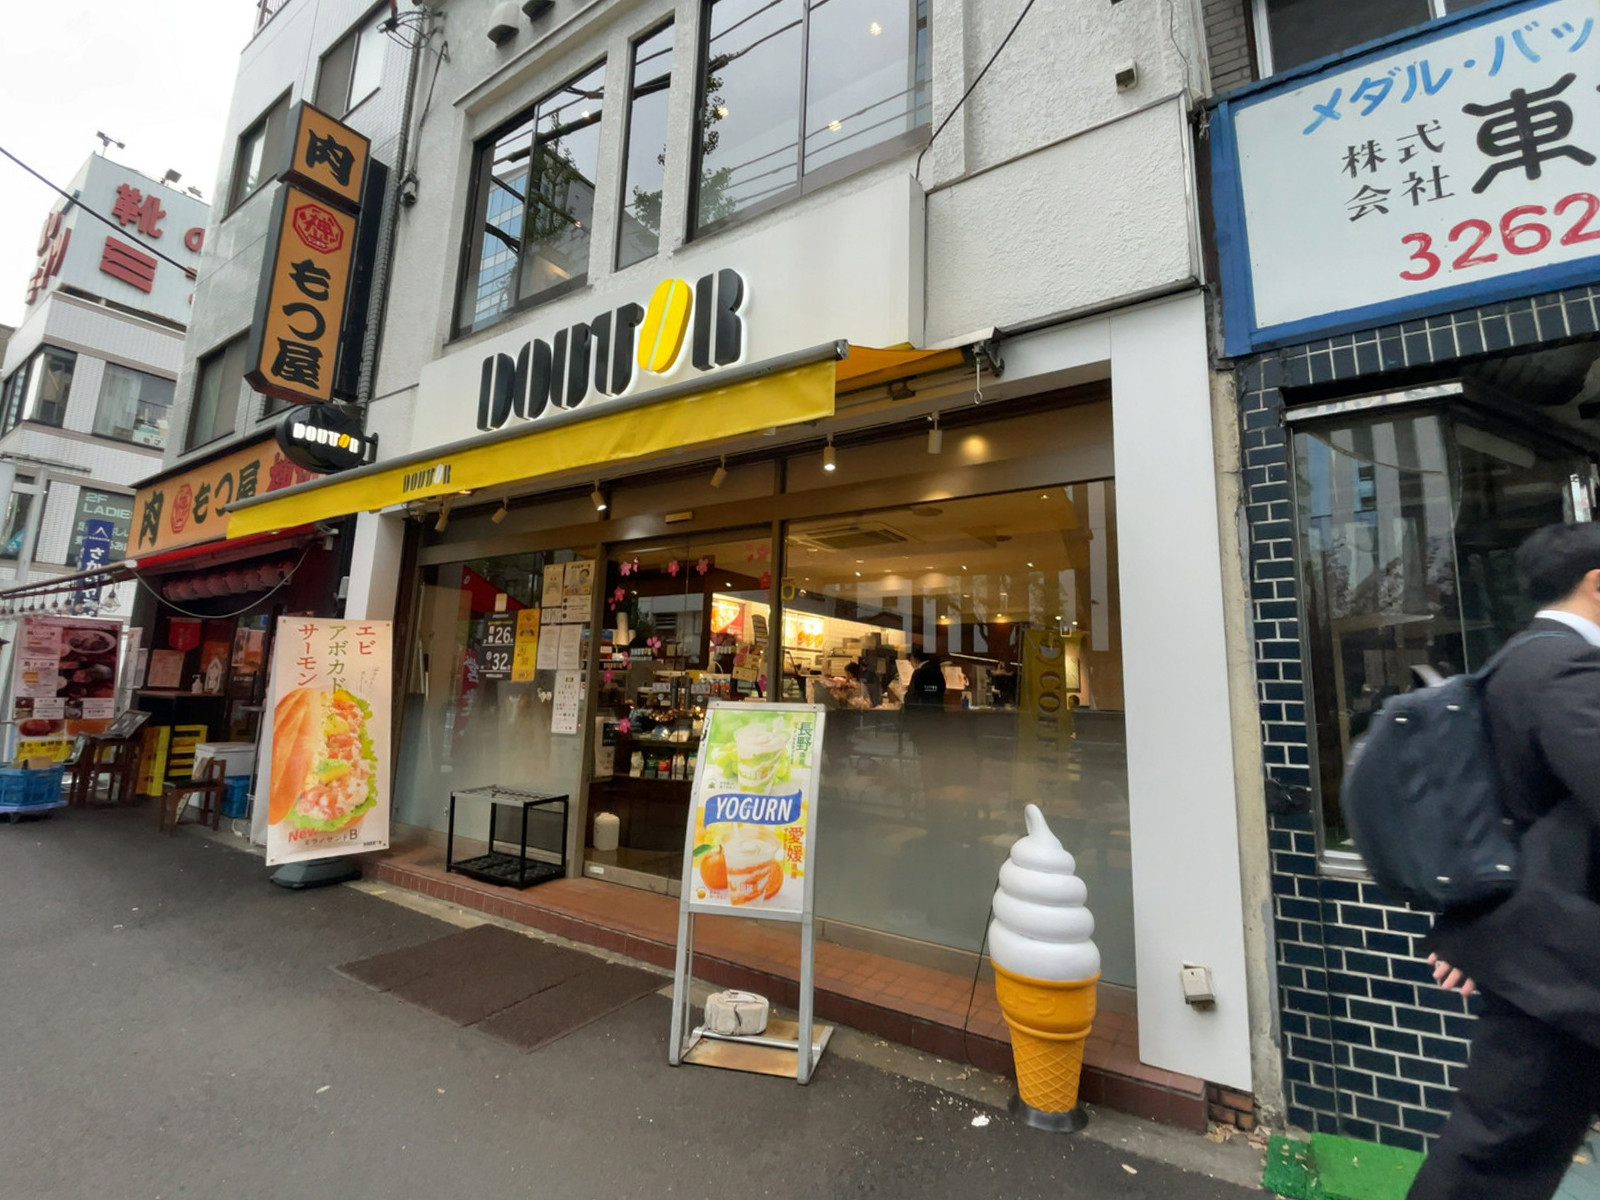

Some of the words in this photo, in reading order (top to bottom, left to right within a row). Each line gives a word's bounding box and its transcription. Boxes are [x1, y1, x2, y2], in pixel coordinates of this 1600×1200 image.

[305, 128, 355, 187] 肉
[1341, 119, 1446, 179] 株式
[1344, 165, 1456, 222] 会社
[1399, 192, 1600, 281] 3262
[270, 258, 332, 390] もつ屋
[476, 267, 746, 432] DOUTOR
[292, 422, 360, 454] DOUTOR
[192, 459, 260, 524] もつ屋
[403, 464, 451, 493] DOUTOR
[83, 503, 132, 520] LADIE
[138, 490, 164, 551] 肉
[296, 624, 319, 687] サーモン
[326, 625, 348, 694] アボカド
[356, 625, 376, 656] エビ
[288, 827, 318, 844] New
[715, 796, 794, 822] YOGURN
